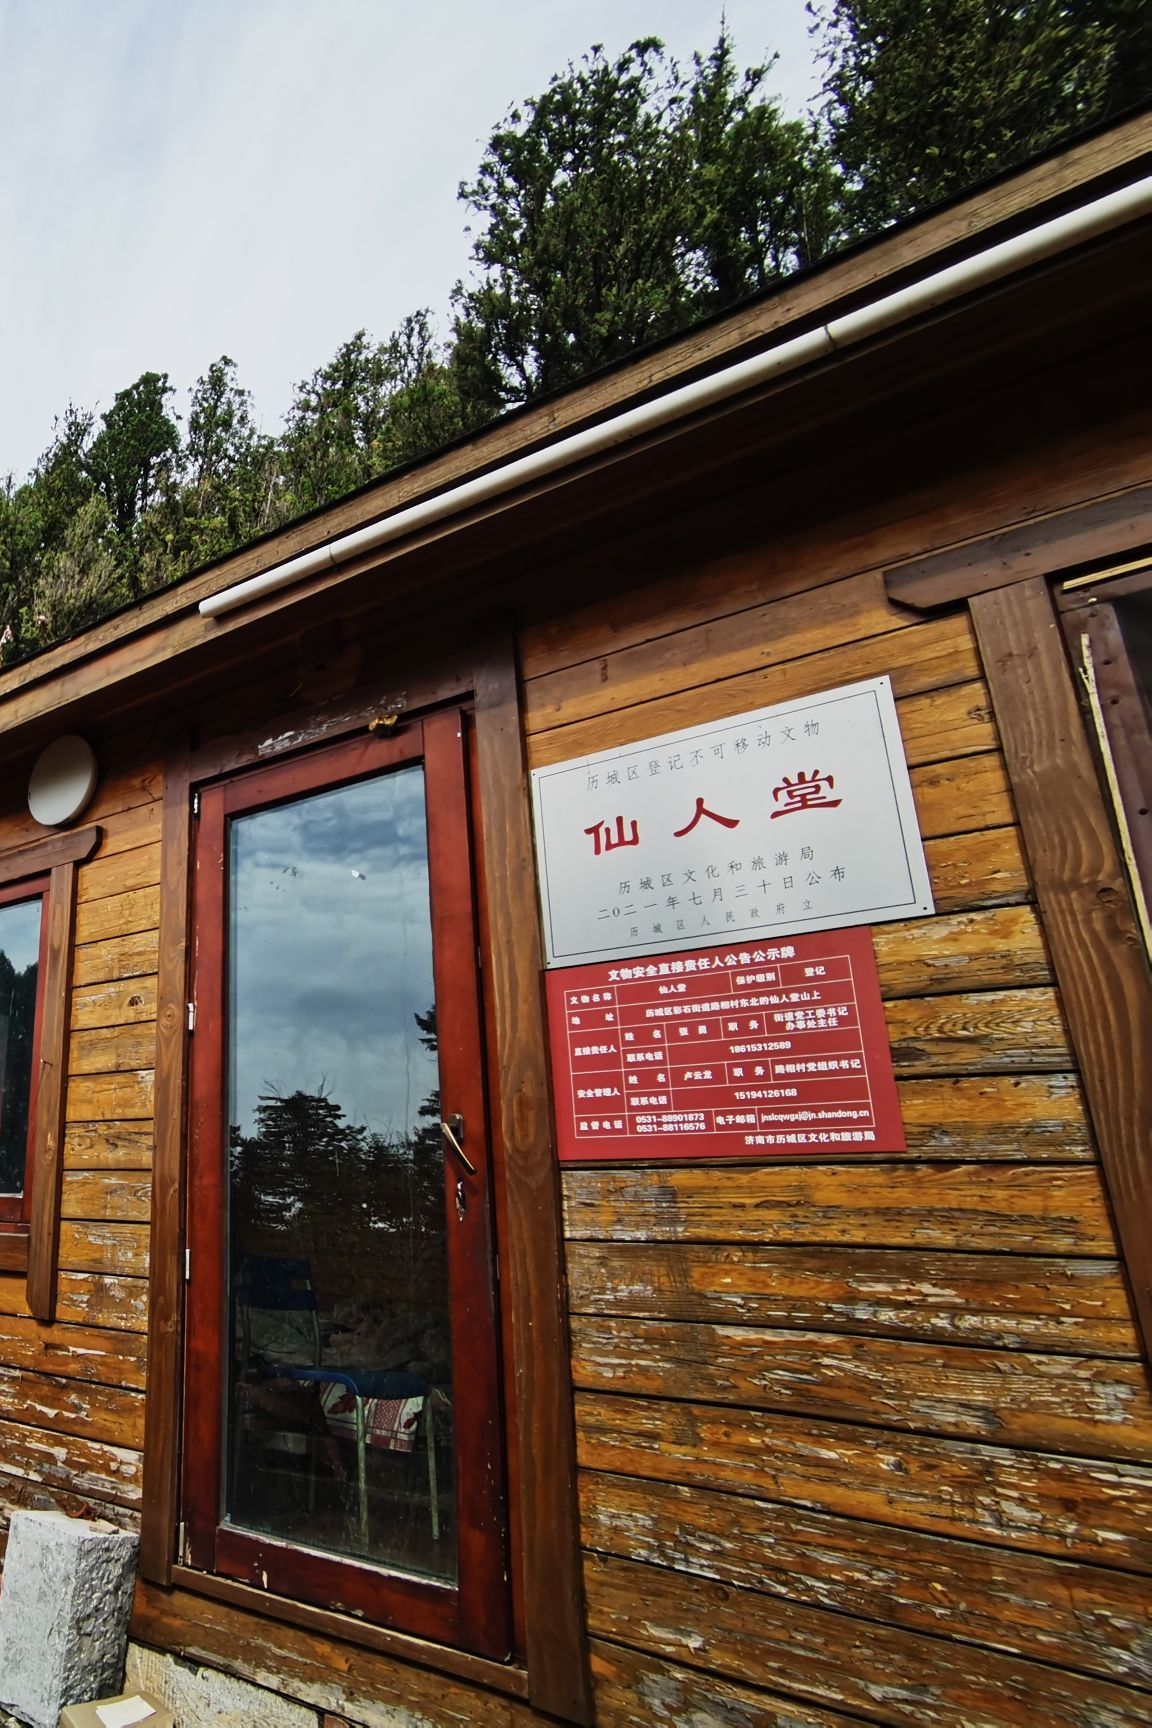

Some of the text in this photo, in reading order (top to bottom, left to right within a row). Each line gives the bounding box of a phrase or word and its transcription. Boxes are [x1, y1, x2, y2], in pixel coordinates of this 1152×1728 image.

[586, 719, 821, 792] 历城区登记不可移动文物
[584, 769, 843, 855] 仙人堂
[618, 846, 815, 895] 历城区文化和旅游局
[630, 899, 814, 938] 历城区人民政府立
[608, 946, 796, 982] 文物安全直接责任人公告公示牌
[804, 966, 826, 977] 登记
[736, 972, 776, 985] 保护级别
[658, 983, 687, 995] 仙人堂
[729, 1040, 792, 1054] 18615312589
[626, 1051, 664, 1063] 联系电话
[684, 1070, 713, 1081] 卢云龙
[577, 1087, 621, 1099] 安全管理人
[734, 1088, 798, 1100] 15194126168
[630, 1095, 668, 1107] 联系电话
[744, 1130, 876, 1146] 济南市历城区文化和旅游局
